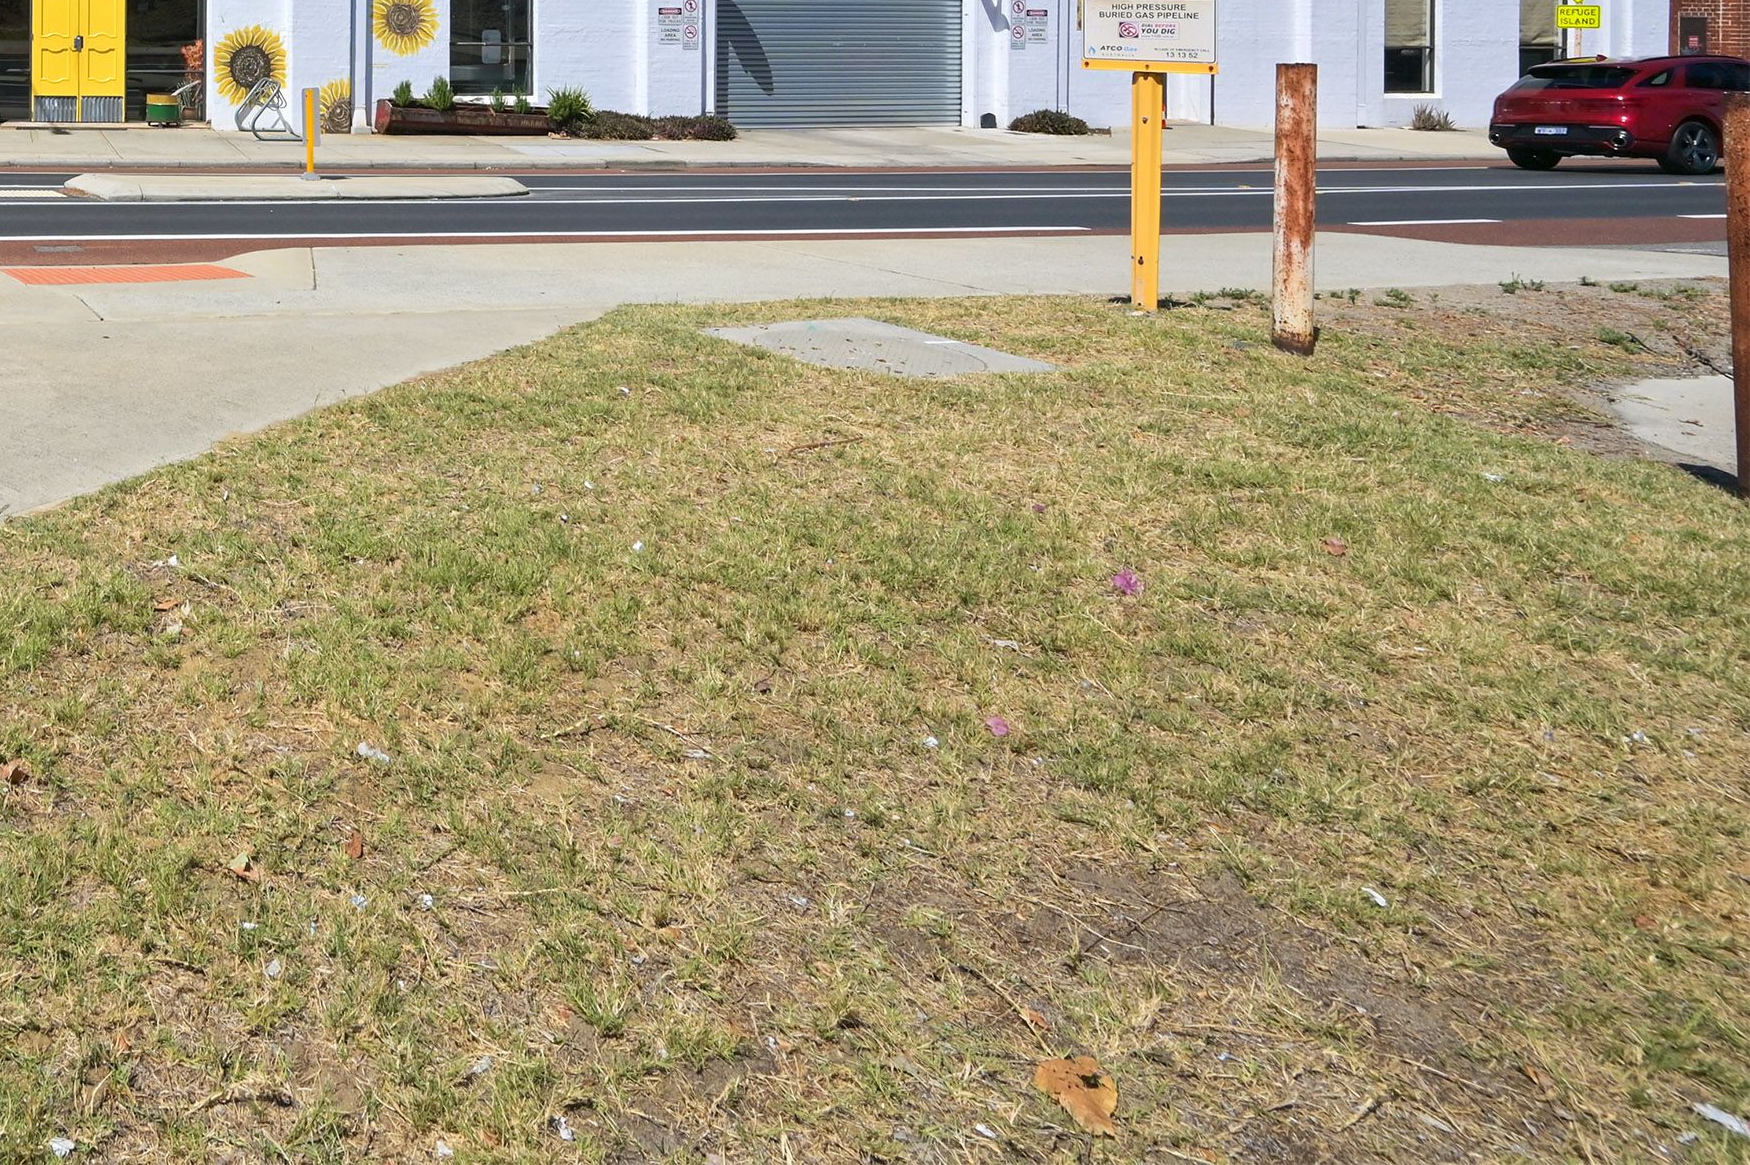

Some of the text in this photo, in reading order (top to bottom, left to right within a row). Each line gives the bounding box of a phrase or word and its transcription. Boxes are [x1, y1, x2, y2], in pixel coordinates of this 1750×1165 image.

[1099, 11, 1133, 19] BURIED
[1157, 12, 1200, 20] PIPELINE
[1560, 8, 1597, 16] REFUGE
